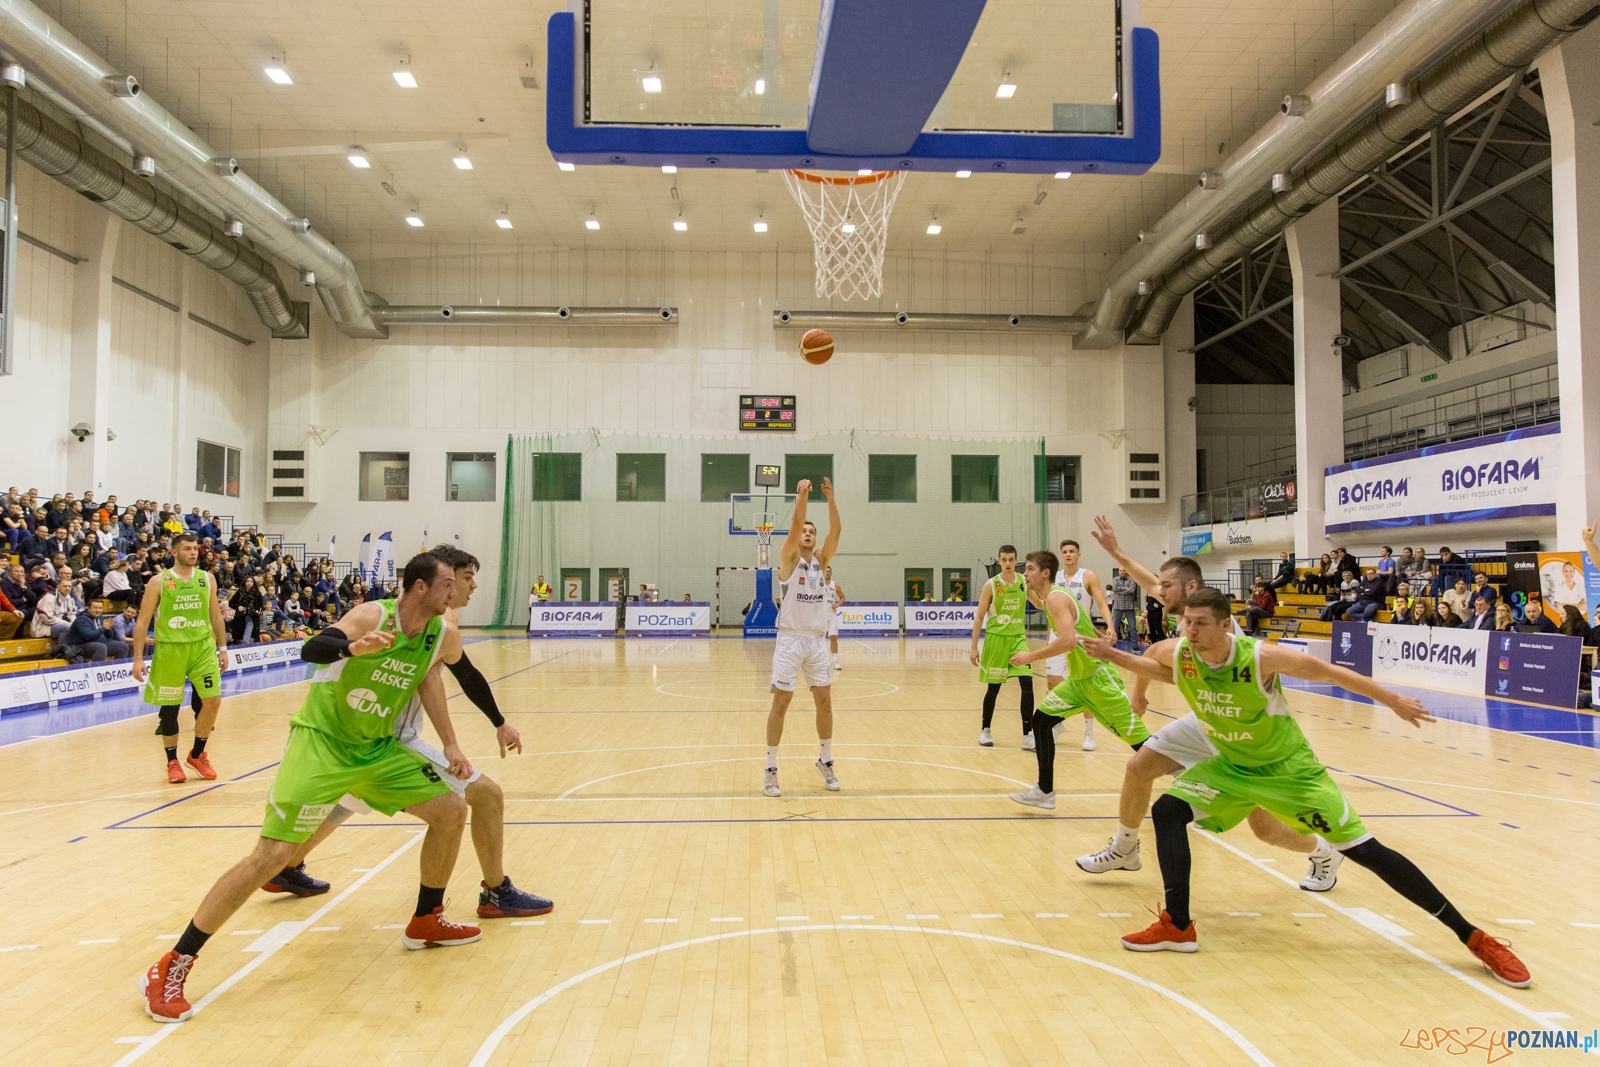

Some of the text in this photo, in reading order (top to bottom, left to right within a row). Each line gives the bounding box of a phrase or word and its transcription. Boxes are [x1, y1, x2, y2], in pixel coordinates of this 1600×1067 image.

[762, 398, 779, 406] 5:24
[744, 411, 756, 419] 23
[781, 411, 792, 420] 22
[762, 466, 779, 475] 5:24
[1441, 457, 1540, 492] BIOFARM
[1448, 493, 1469, 501] POLSKI
[1471, 488, 1506, 498] PRODUCENT
[1229, 535, 1253, 545] Budchem
[1514, 561, 1535, 569] drukma
[198, 578, 206, 588] 5
[568, 583, 577, 598] 2
[911, 583, 920, 599] 1
[954, 583, 964, 598] 2
[175, 594, 200, 602] ZNICZ
[173, 602, 203, 611] BASKET
[541, 611, 603, 621] BIOFARM
[842, 612, 892, 621] funclub
[915, 610, 975, 621] BIOFARM
[242, 652, 261, 662] NICKEL
[1401, 640, 1477, 667] BIOFARM
[380, 657, 417, 676] ZNICZ
[371, 669, 413, 690] BASKE
[1231, 666, 1252, 683] 14
[203, 675, 214, 689] 5
[1197, 689, 1234, 704] ZNICZ
[1195, 702, 1242, 718] BASKET
